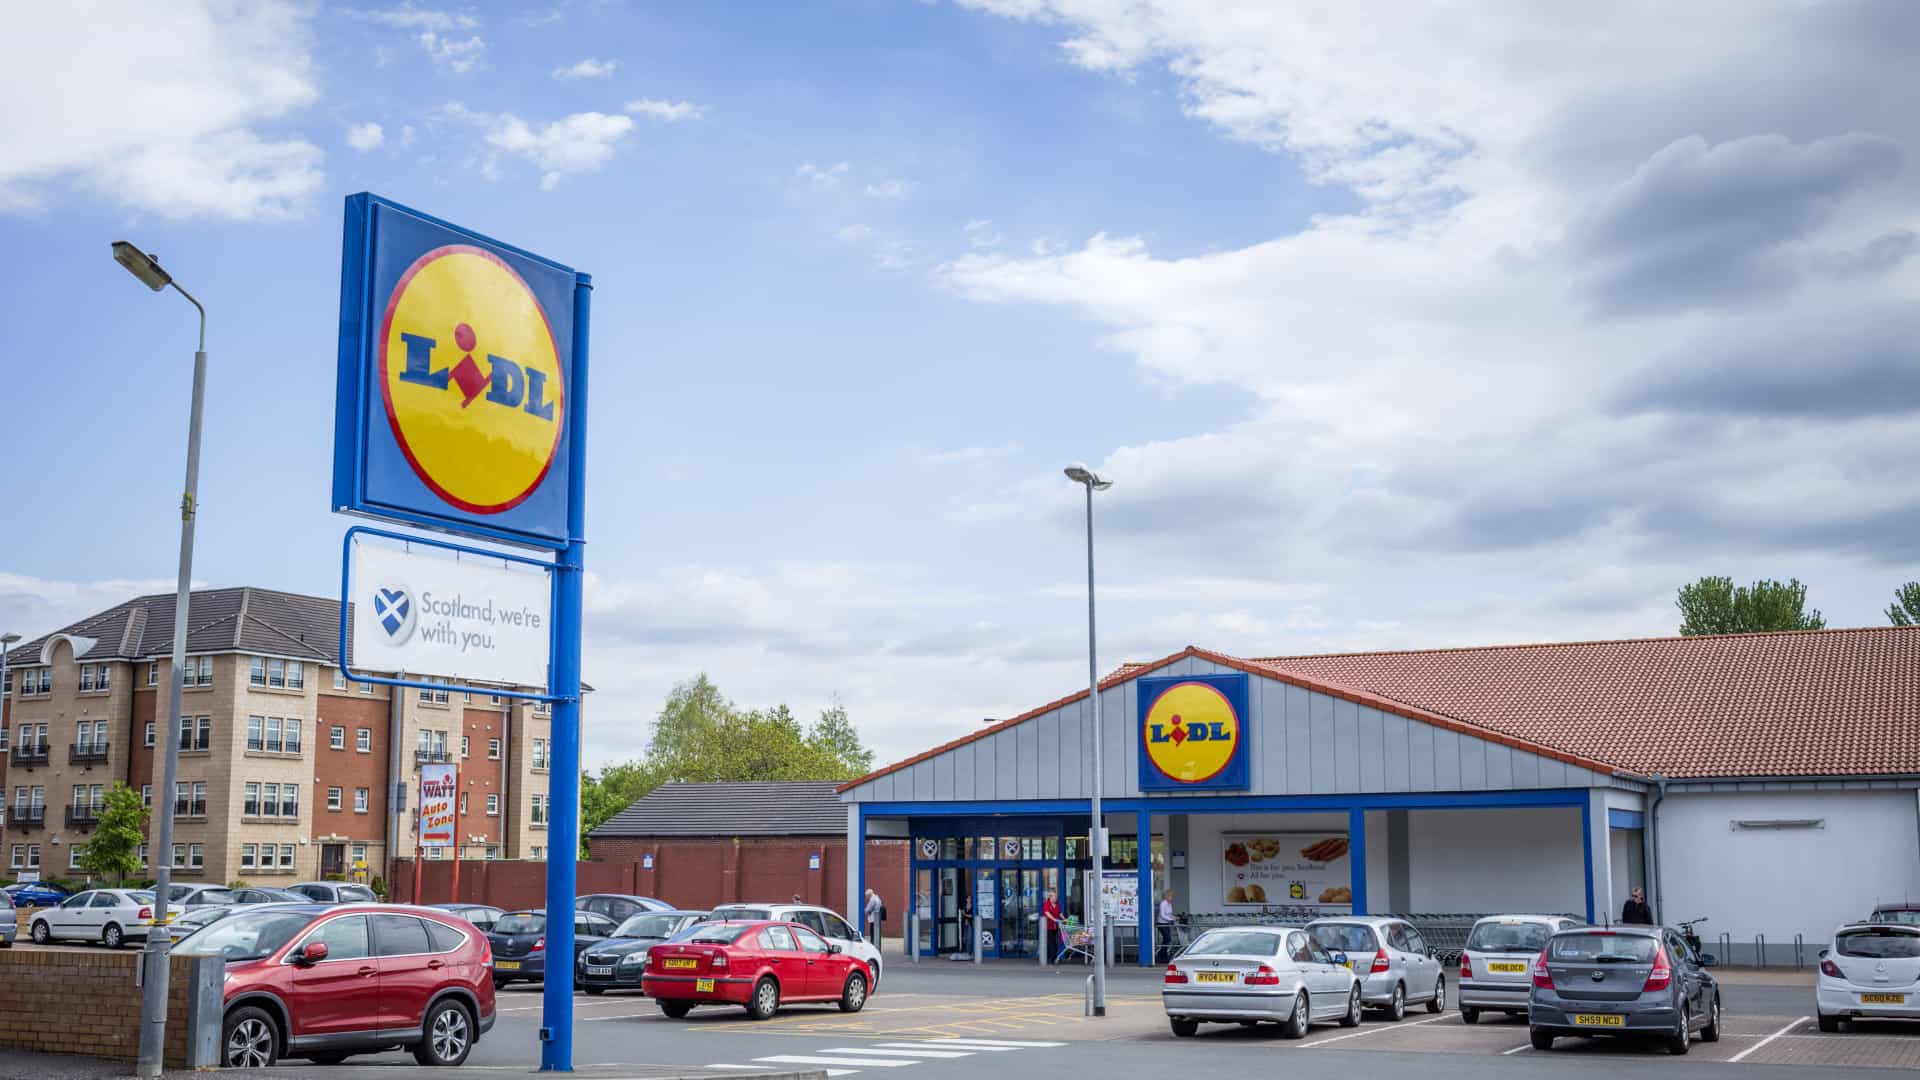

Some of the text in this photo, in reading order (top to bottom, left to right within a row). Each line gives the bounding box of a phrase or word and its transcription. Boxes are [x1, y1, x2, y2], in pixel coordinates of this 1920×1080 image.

[422, 592, 541, 629] Scotland, we're
[421, 621, 495, 652] with you.
[423, 784, 455, 799] WATT
[423, 802, 448, 816] Auto
[428, 815, 453, 829] Zone
[1578, 1015, 1601, 1024] SH59
